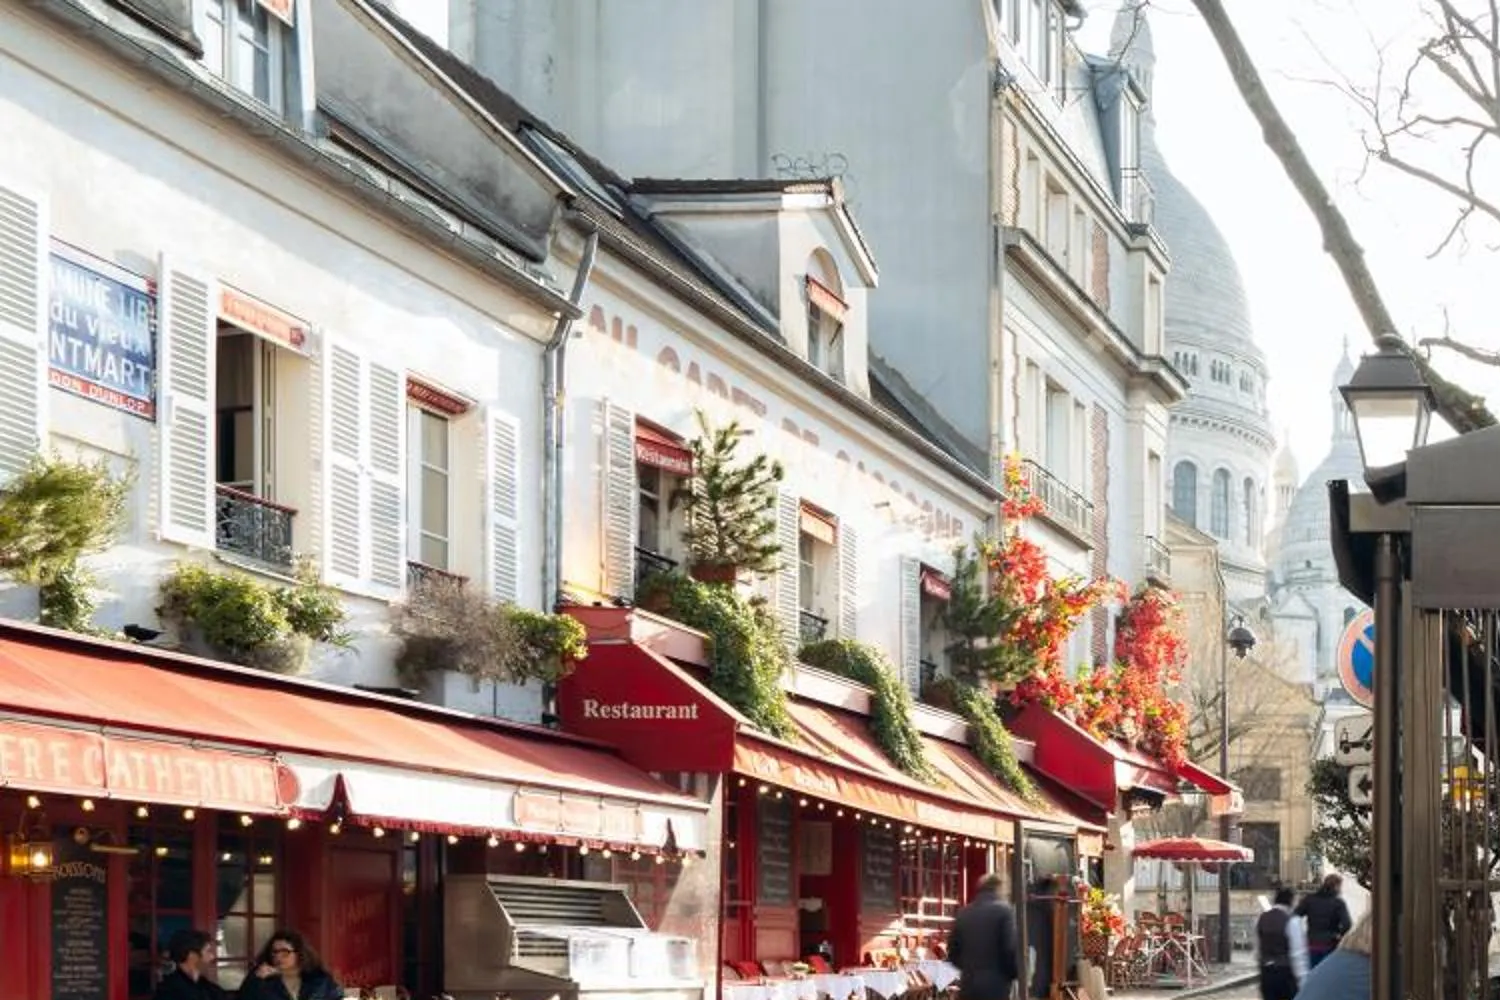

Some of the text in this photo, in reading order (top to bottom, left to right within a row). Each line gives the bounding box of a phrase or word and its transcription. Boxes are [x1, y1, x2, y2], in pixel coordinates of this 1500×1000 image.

[51, 298, 77, 329] du
[583, 698, 699, 721] Restaurant
[82, 744, 274, 803] CATHERINE
